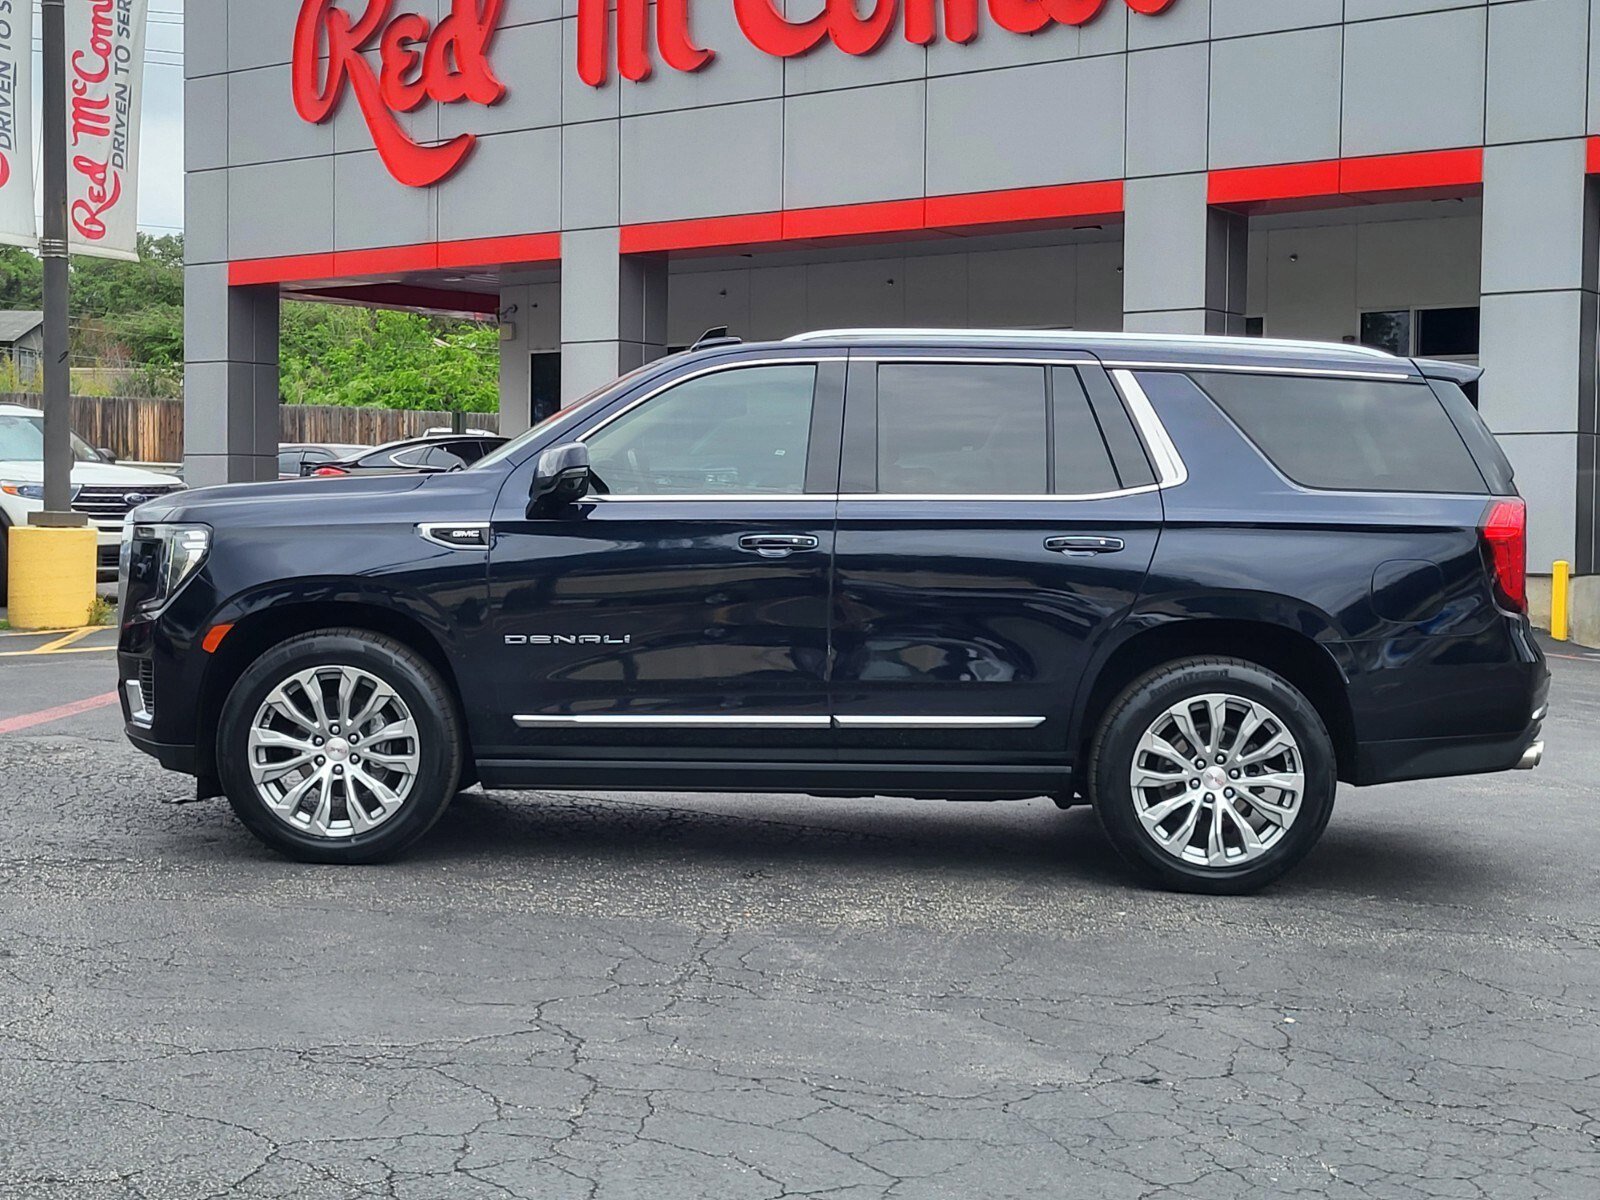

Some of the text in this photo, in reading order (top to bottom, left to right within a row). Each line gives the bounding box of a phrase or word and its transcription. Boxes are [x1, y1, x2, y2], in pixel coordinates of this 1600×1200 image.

[114, 44, 131, 75] TO
[71, 0, 121, 240] Red McCom
[291, 0, 507, 187] Red
[112, 83, 128, 170] DRIVEN
[452, 530, 480, 538] GMC
[504, 634, 632, 645] DENALI
